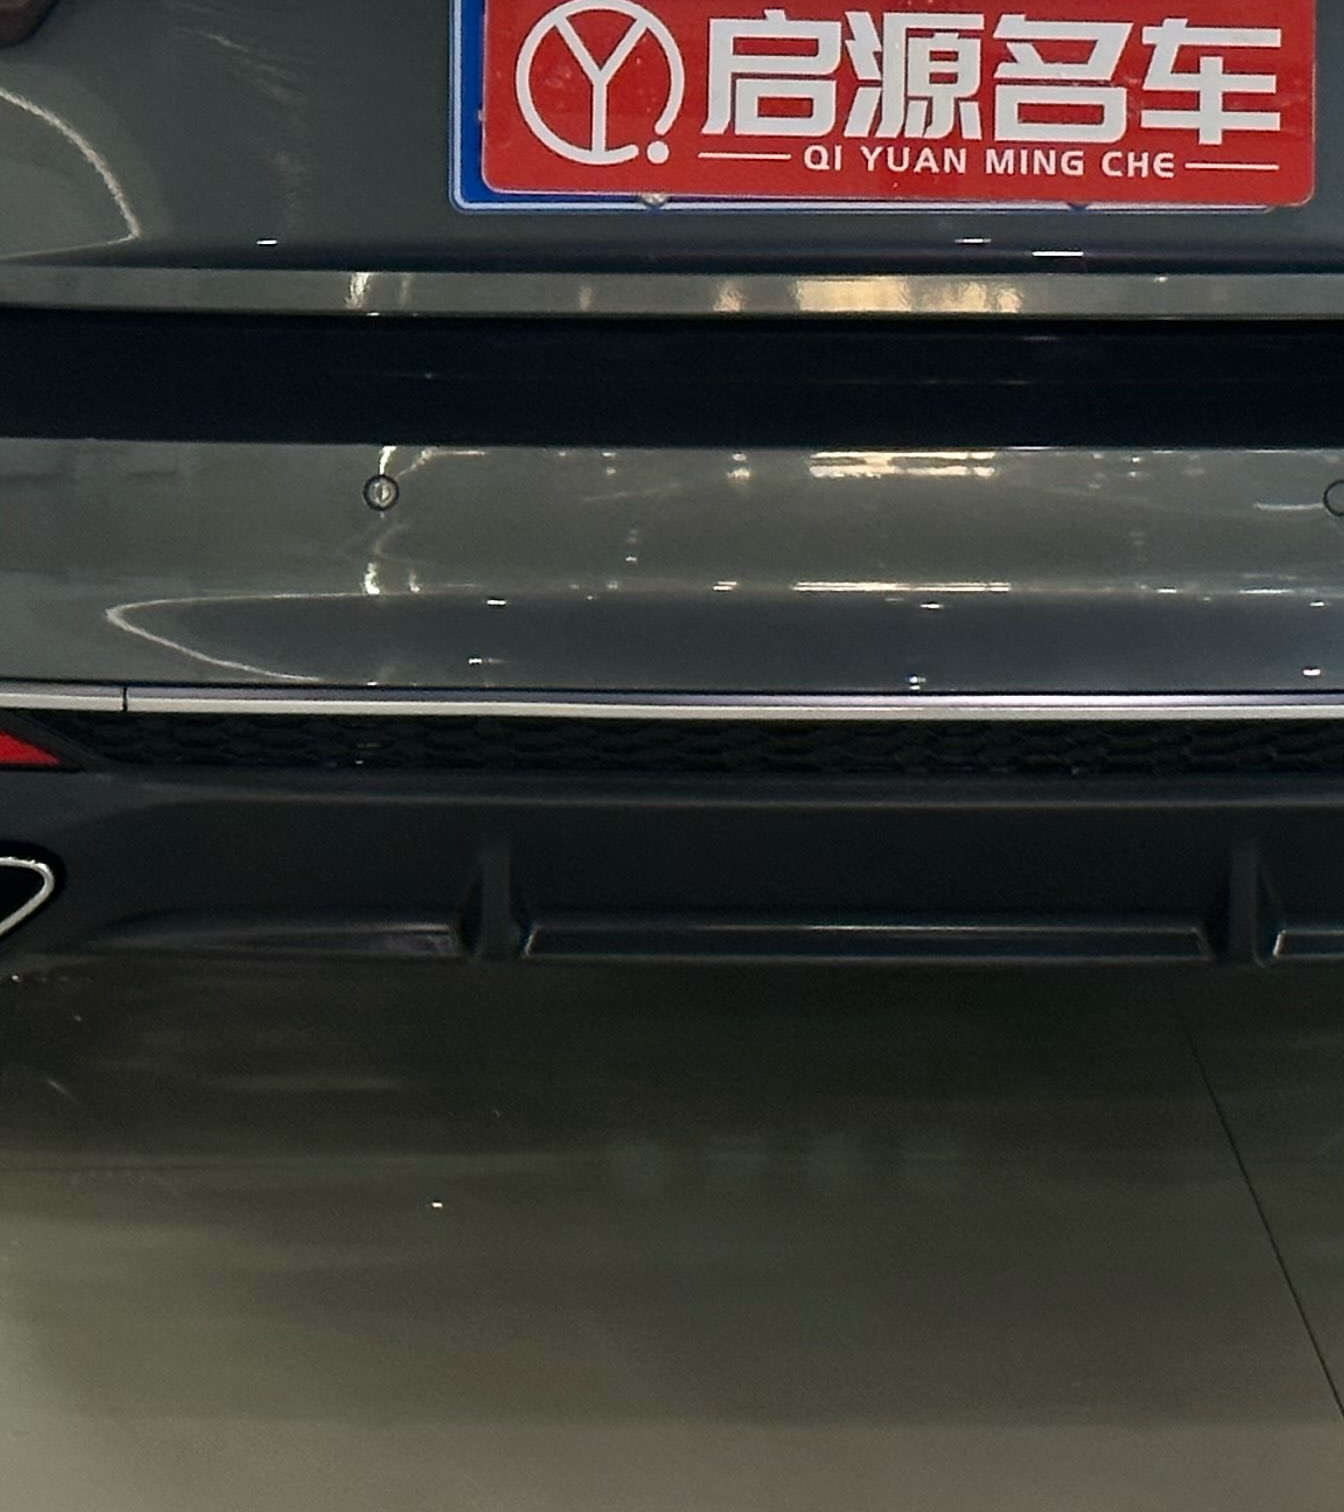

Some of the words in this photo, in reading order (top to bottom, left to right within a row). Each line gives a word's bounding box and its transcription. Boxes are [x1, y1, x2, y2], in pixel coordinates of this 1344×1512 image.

[702, 9, 1281, 144] 启源名车
[804, 144, 843, 171] QI
[860, 146, 967, 174] YUAN
[985, 148, 1086, 176] MING
[1101, 151, 1176, 178] CHE
